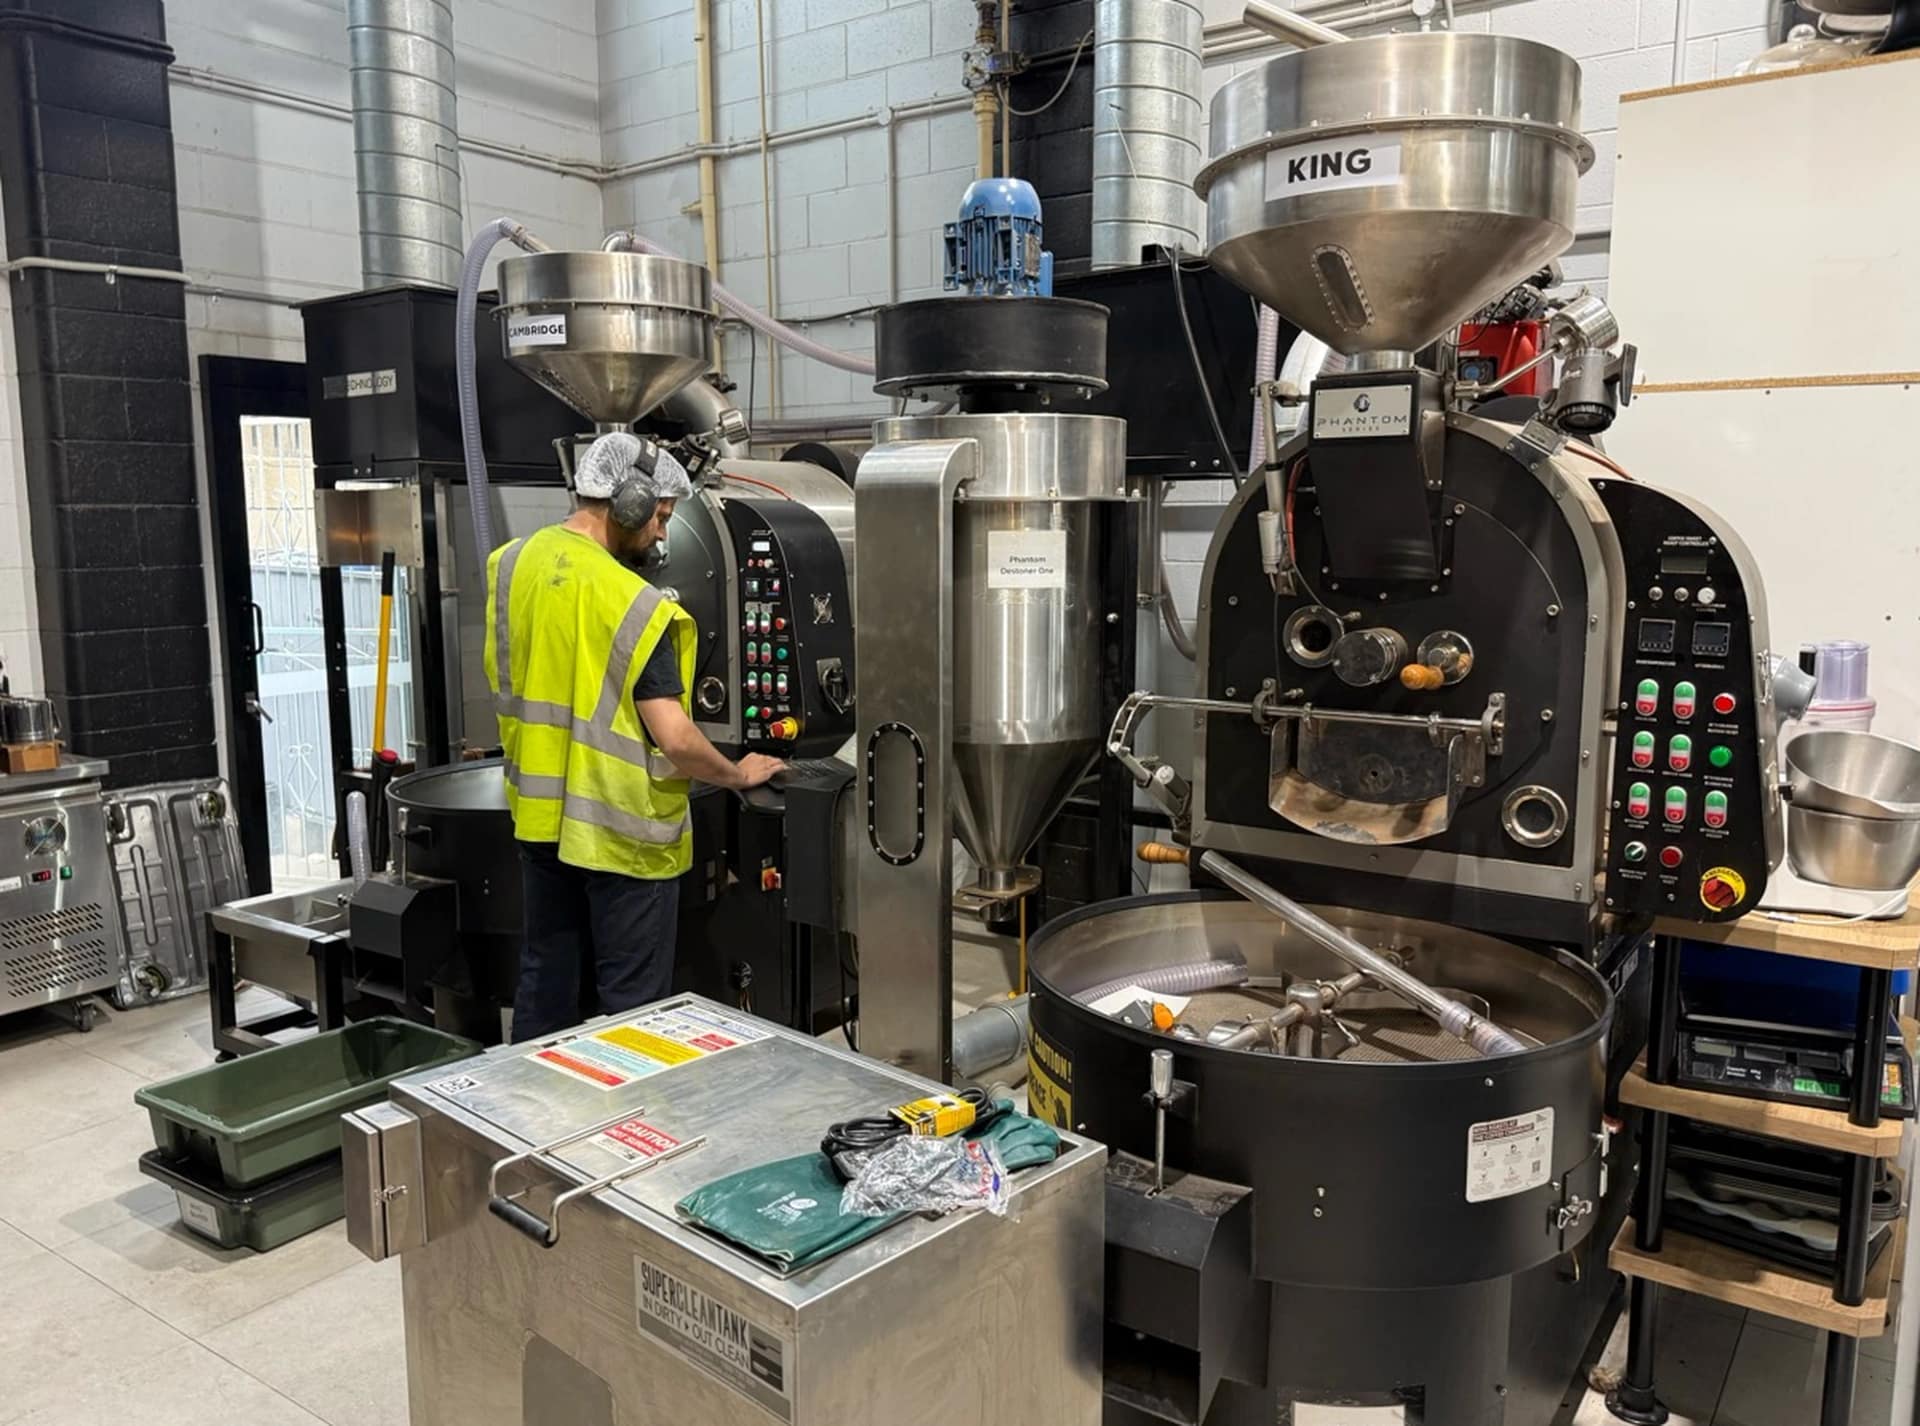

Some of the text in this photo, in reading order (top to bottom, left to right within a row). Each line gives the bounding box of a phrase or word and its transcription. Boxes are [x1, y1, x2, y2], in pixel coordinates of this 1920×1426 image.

[1288, 148, 1371, 184] KING
[509, 323, 564, 337] CAMBRIDGE
[1317, 415, 1407, 426] PHANTOM
[1009, 555, 1046, 563] Phantom
[1000, 567, 1037, 575] Destoner
[641, 1261, 748, 1350] SUPERCLEANTANK
[643, 1297, 653, 1313] IN
[655, 1301, 683, 1329] DIRTY
[692, 1323, 713, 1346] OUT
[714, 1336, 750, 1369] CLEAN
